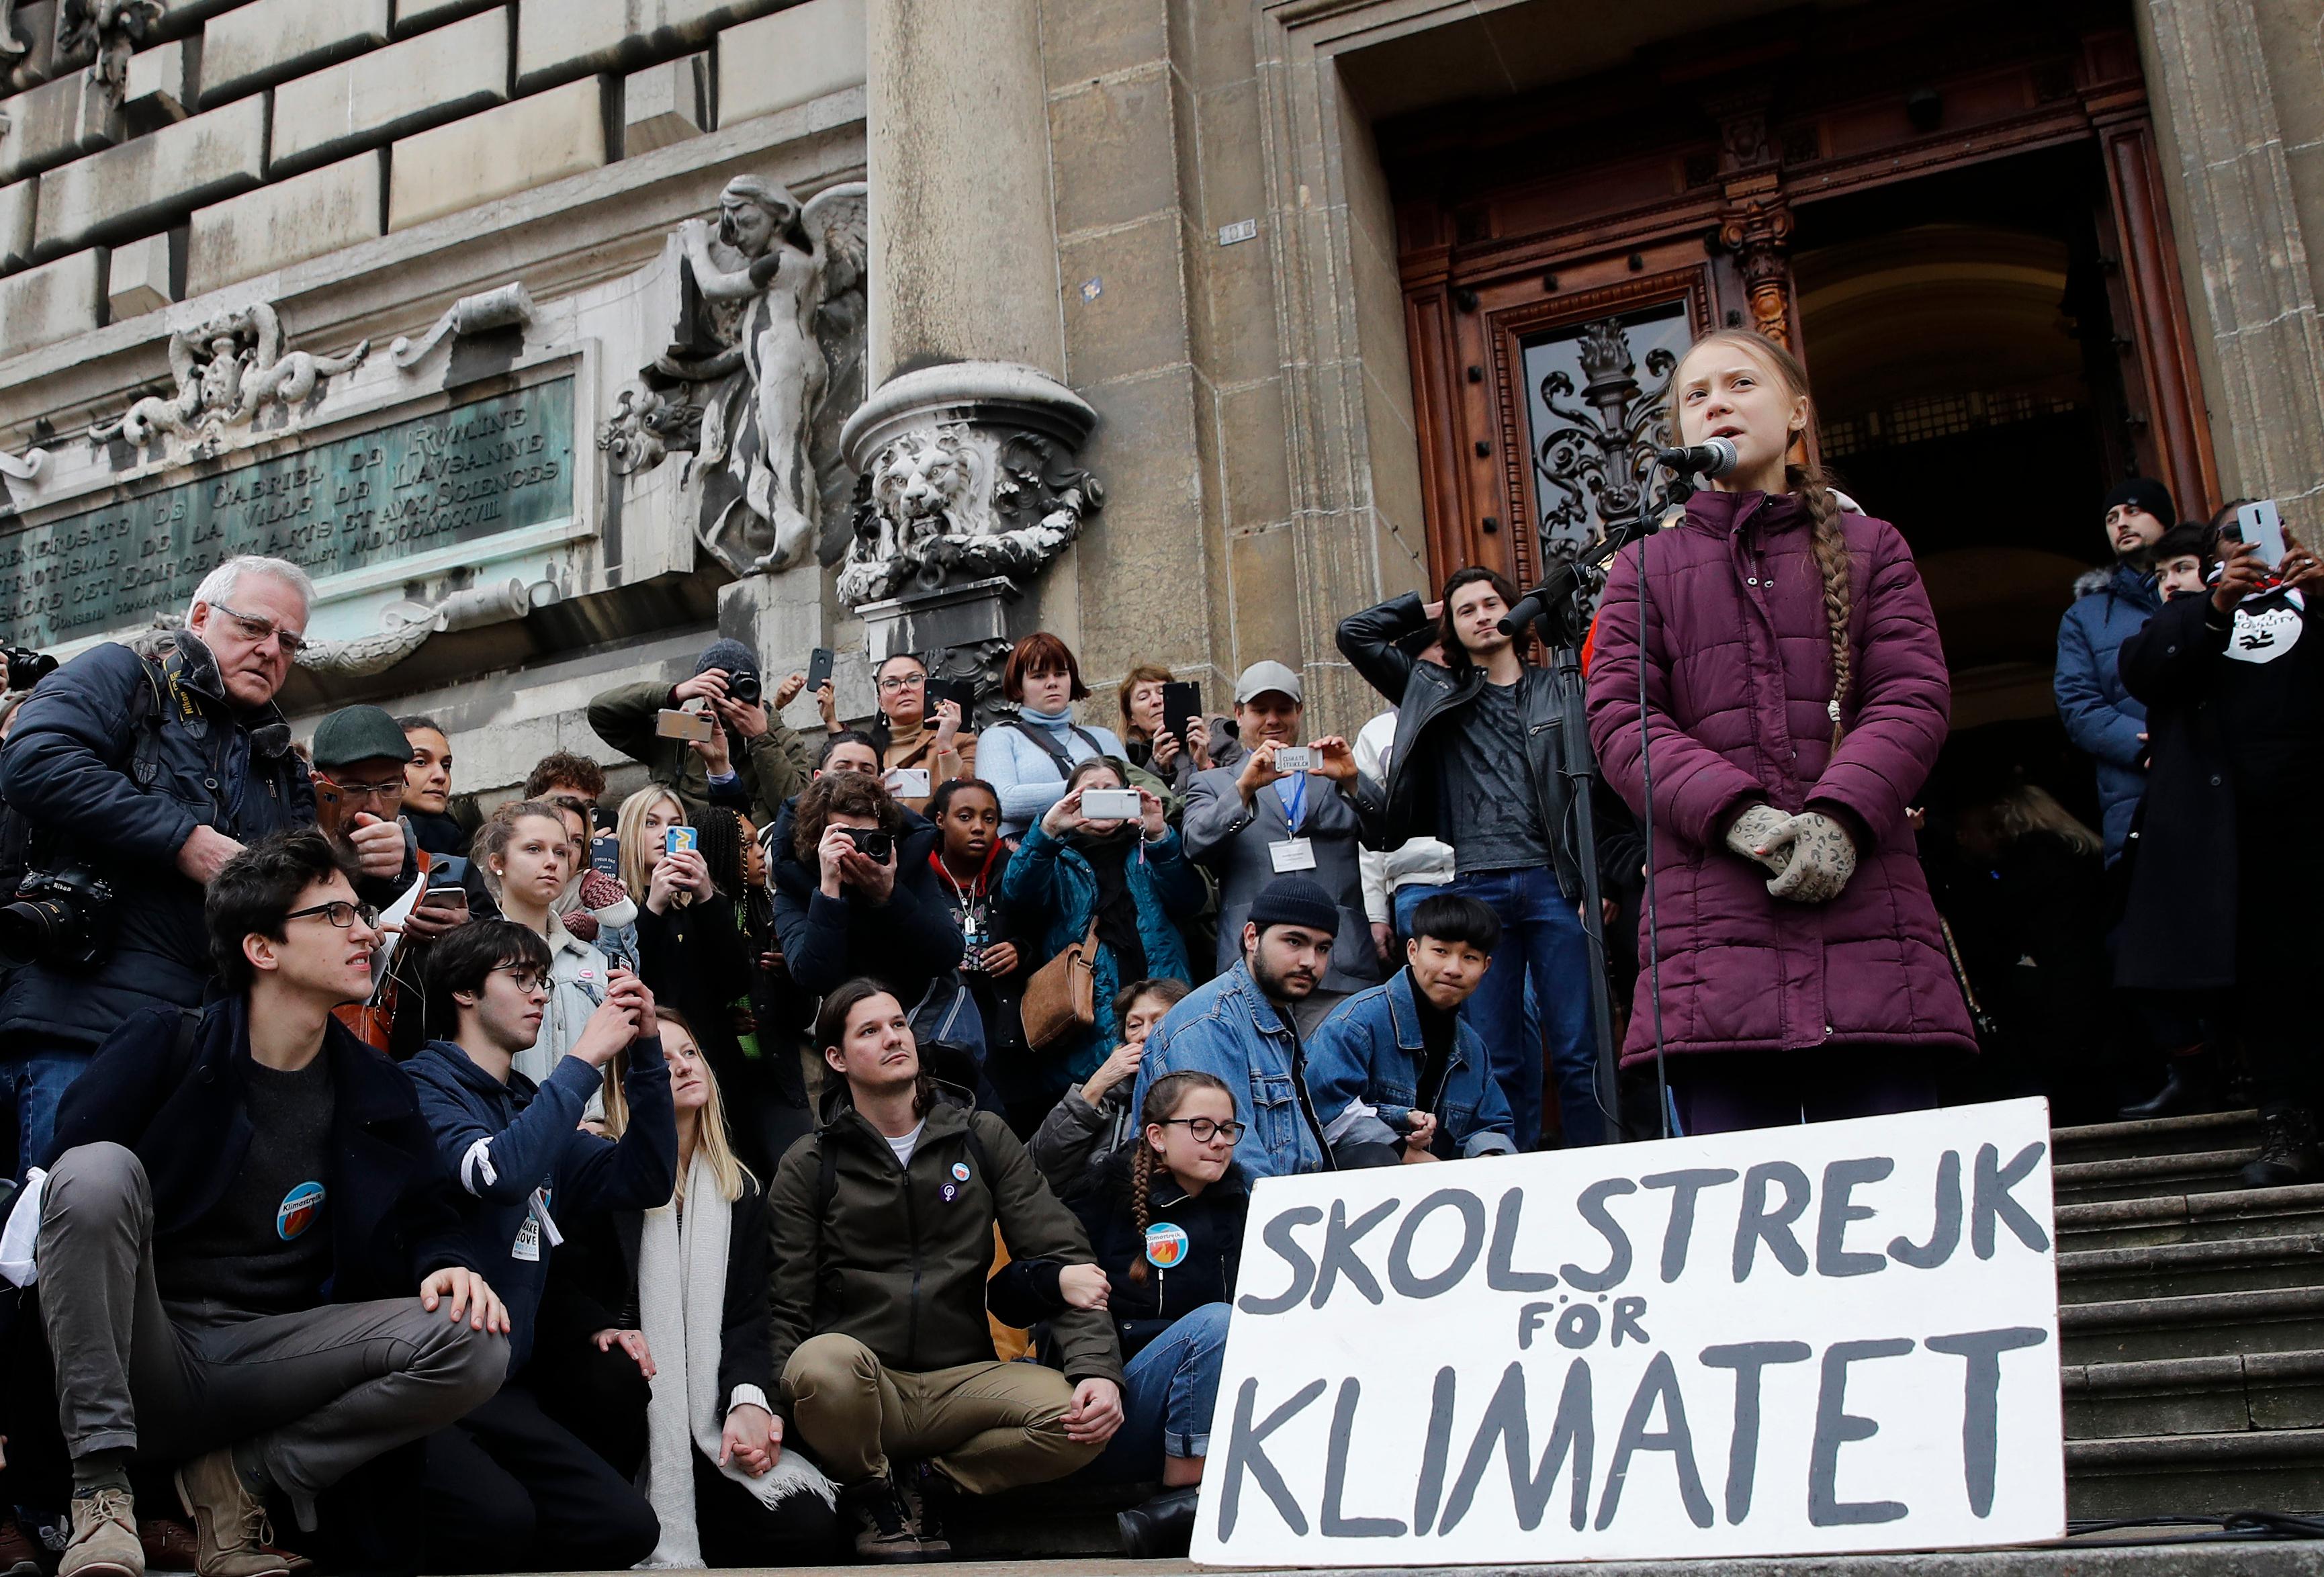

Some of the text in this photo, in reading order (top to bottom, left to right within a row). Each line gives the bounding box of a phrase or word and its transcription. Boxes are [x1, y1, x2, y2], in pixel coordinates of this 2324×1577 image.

[153, 503, 185, 527] DE
[212, 465, 324, 510] GABRIEL
[349, 448, 384, 472] DE
[71, 577, 115, 604] CET
[120, 554, 210, 591] EDIFICE
[264, 521, 334, 555] ARTS
[341, 510, 376, 533] ET
[429, 461, 559, 516] SCIENCES
[139, 535, 171, 558] DE
[192, 523, 224, 545] LA
[240, 497, 313, 530] VILLE
[334, 482, 369, 506] DE
[179, 690, 195, 715] Nikon
[53, 882, 72, 892] Nikon
[283, 1193, 322, 1212] Klimastreik
[1238, 1142, 2047, 1314] SKOLSTREJK
[517, 1231, 537, 1246] LOVE
[1147, 1232, 1181, 1241] Klimastreik
[1519, 1294, 1650, 1349] FÖR
[1218, 1327, 2047, 1543] KLIMATET
